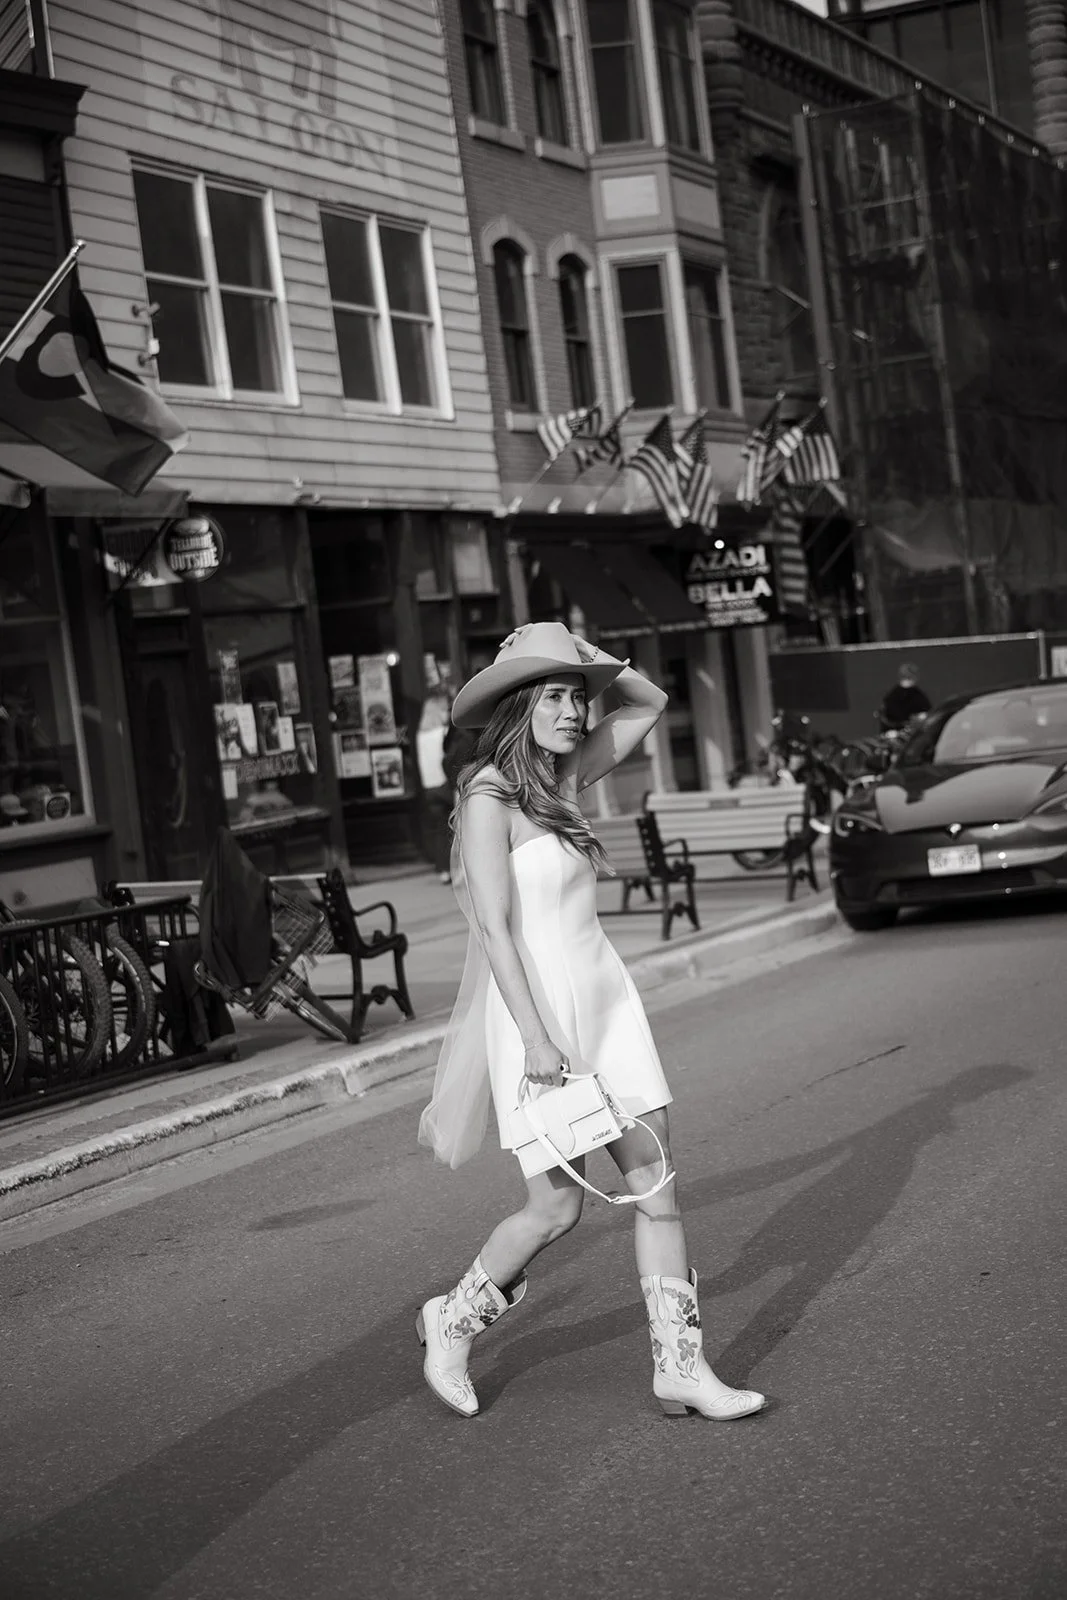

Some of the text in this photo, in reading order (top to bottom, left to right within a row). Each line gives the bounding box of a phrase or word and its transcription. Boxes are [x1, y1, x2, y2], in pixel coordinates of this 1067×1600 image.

[170, 548, 219, 571] OUTSIDE
[690, 544, 766, 572] AZADI
[688, 576, 773, 604] BELLA
